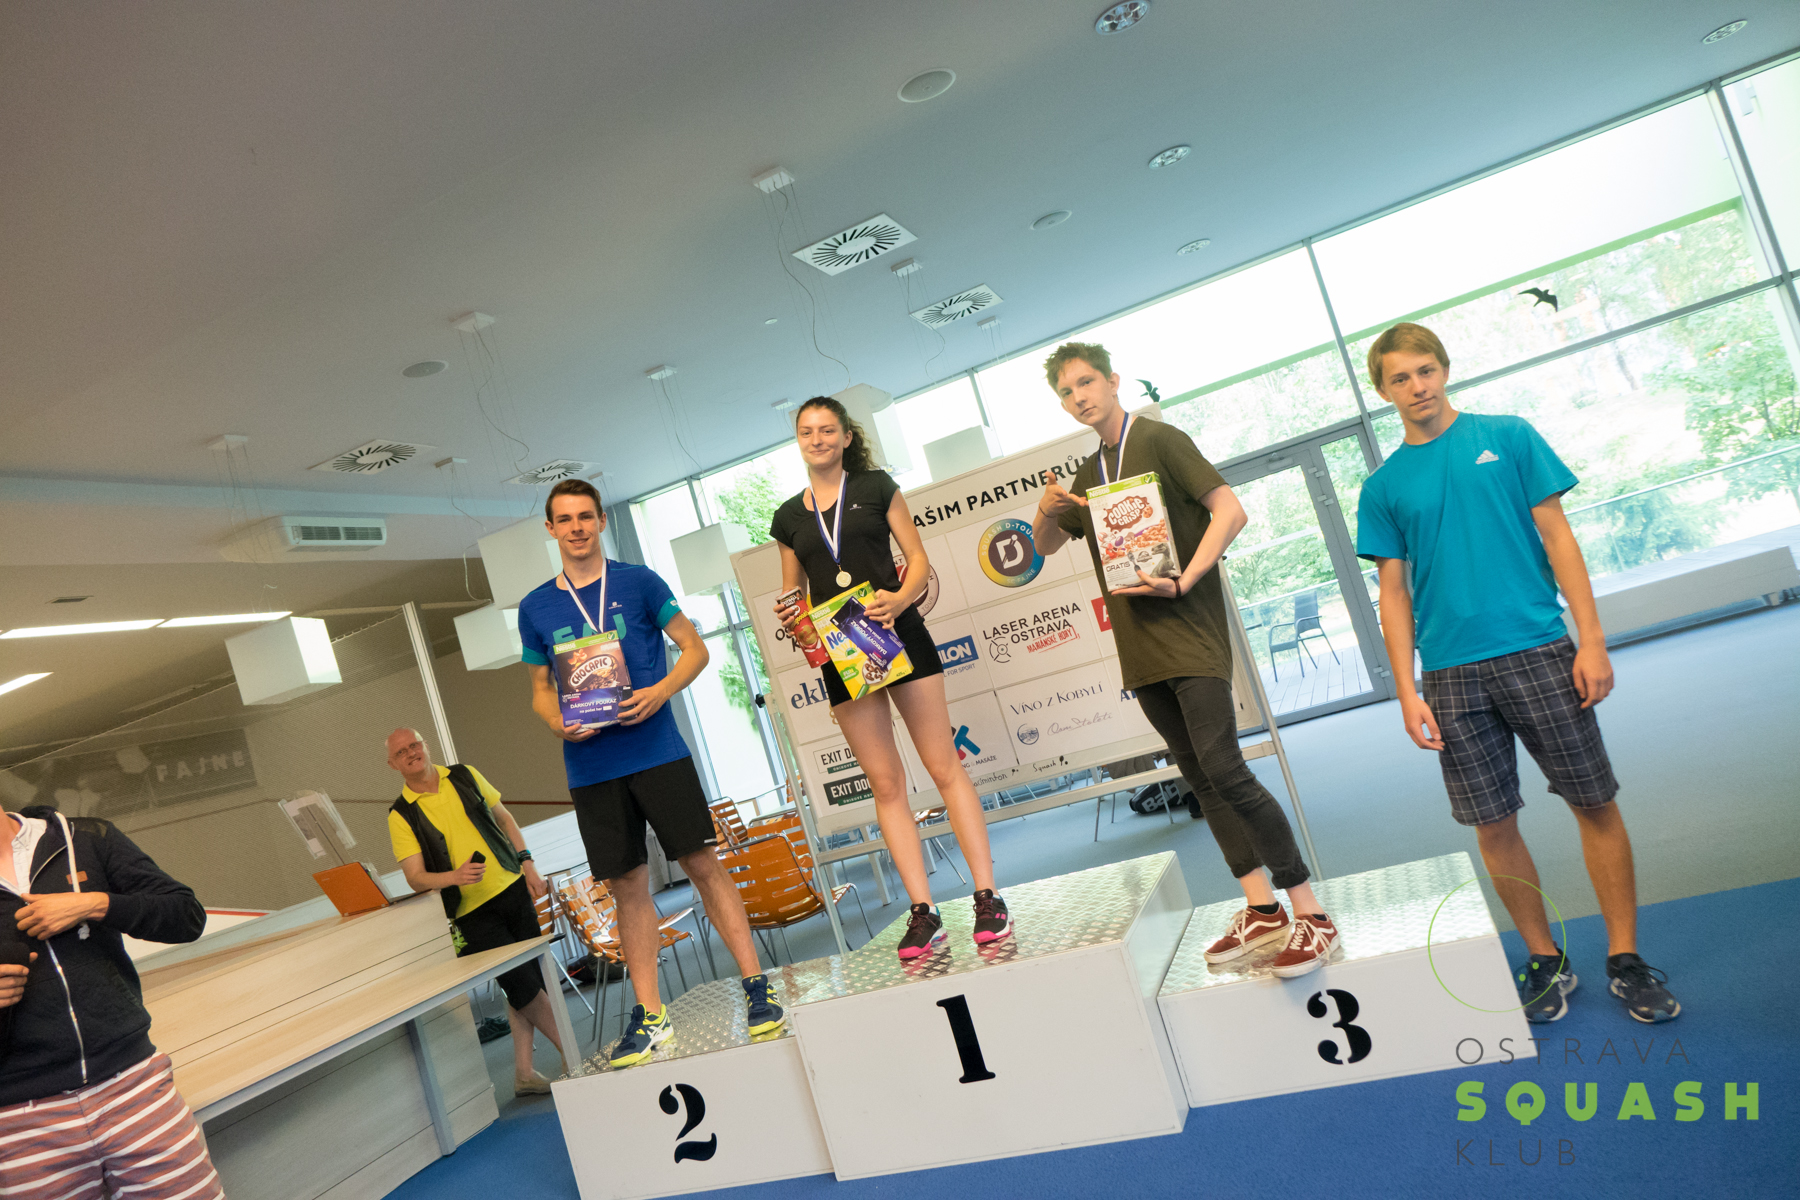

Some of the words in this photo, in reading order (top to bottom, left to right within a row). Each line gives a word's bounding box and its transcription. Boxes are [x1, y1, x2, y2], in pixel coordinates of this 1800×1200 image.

[913, 501, 962, 528] AŠIM
[981, 525, 1003, 556] SQUASH
[1017, 568, 1036, 583] FAJNE
[1105, 561, 1131, 572] GRATIS
[921, 596, 934, 612] TOUR
[983, 618, 1029, 640] LASER
[1032, 602, 1081, 625] ARENA
[1010, 618, 1072, 644] OSTRAVA
[571, 657, 608, 685] CHOCAPIC
[947, 667, 960, 676] FOR
[959, 663, 976, 674] SPORT
[155, 751, 245, 782] FAJNE
[821, 750, 842, 766] EXIT
[830, 782, 852, 798] EXIT
[936, 994, 996, 1085] 1
[1307, 988, 1372, 1066] 3
[659, 1083, 717, 1164] 2
